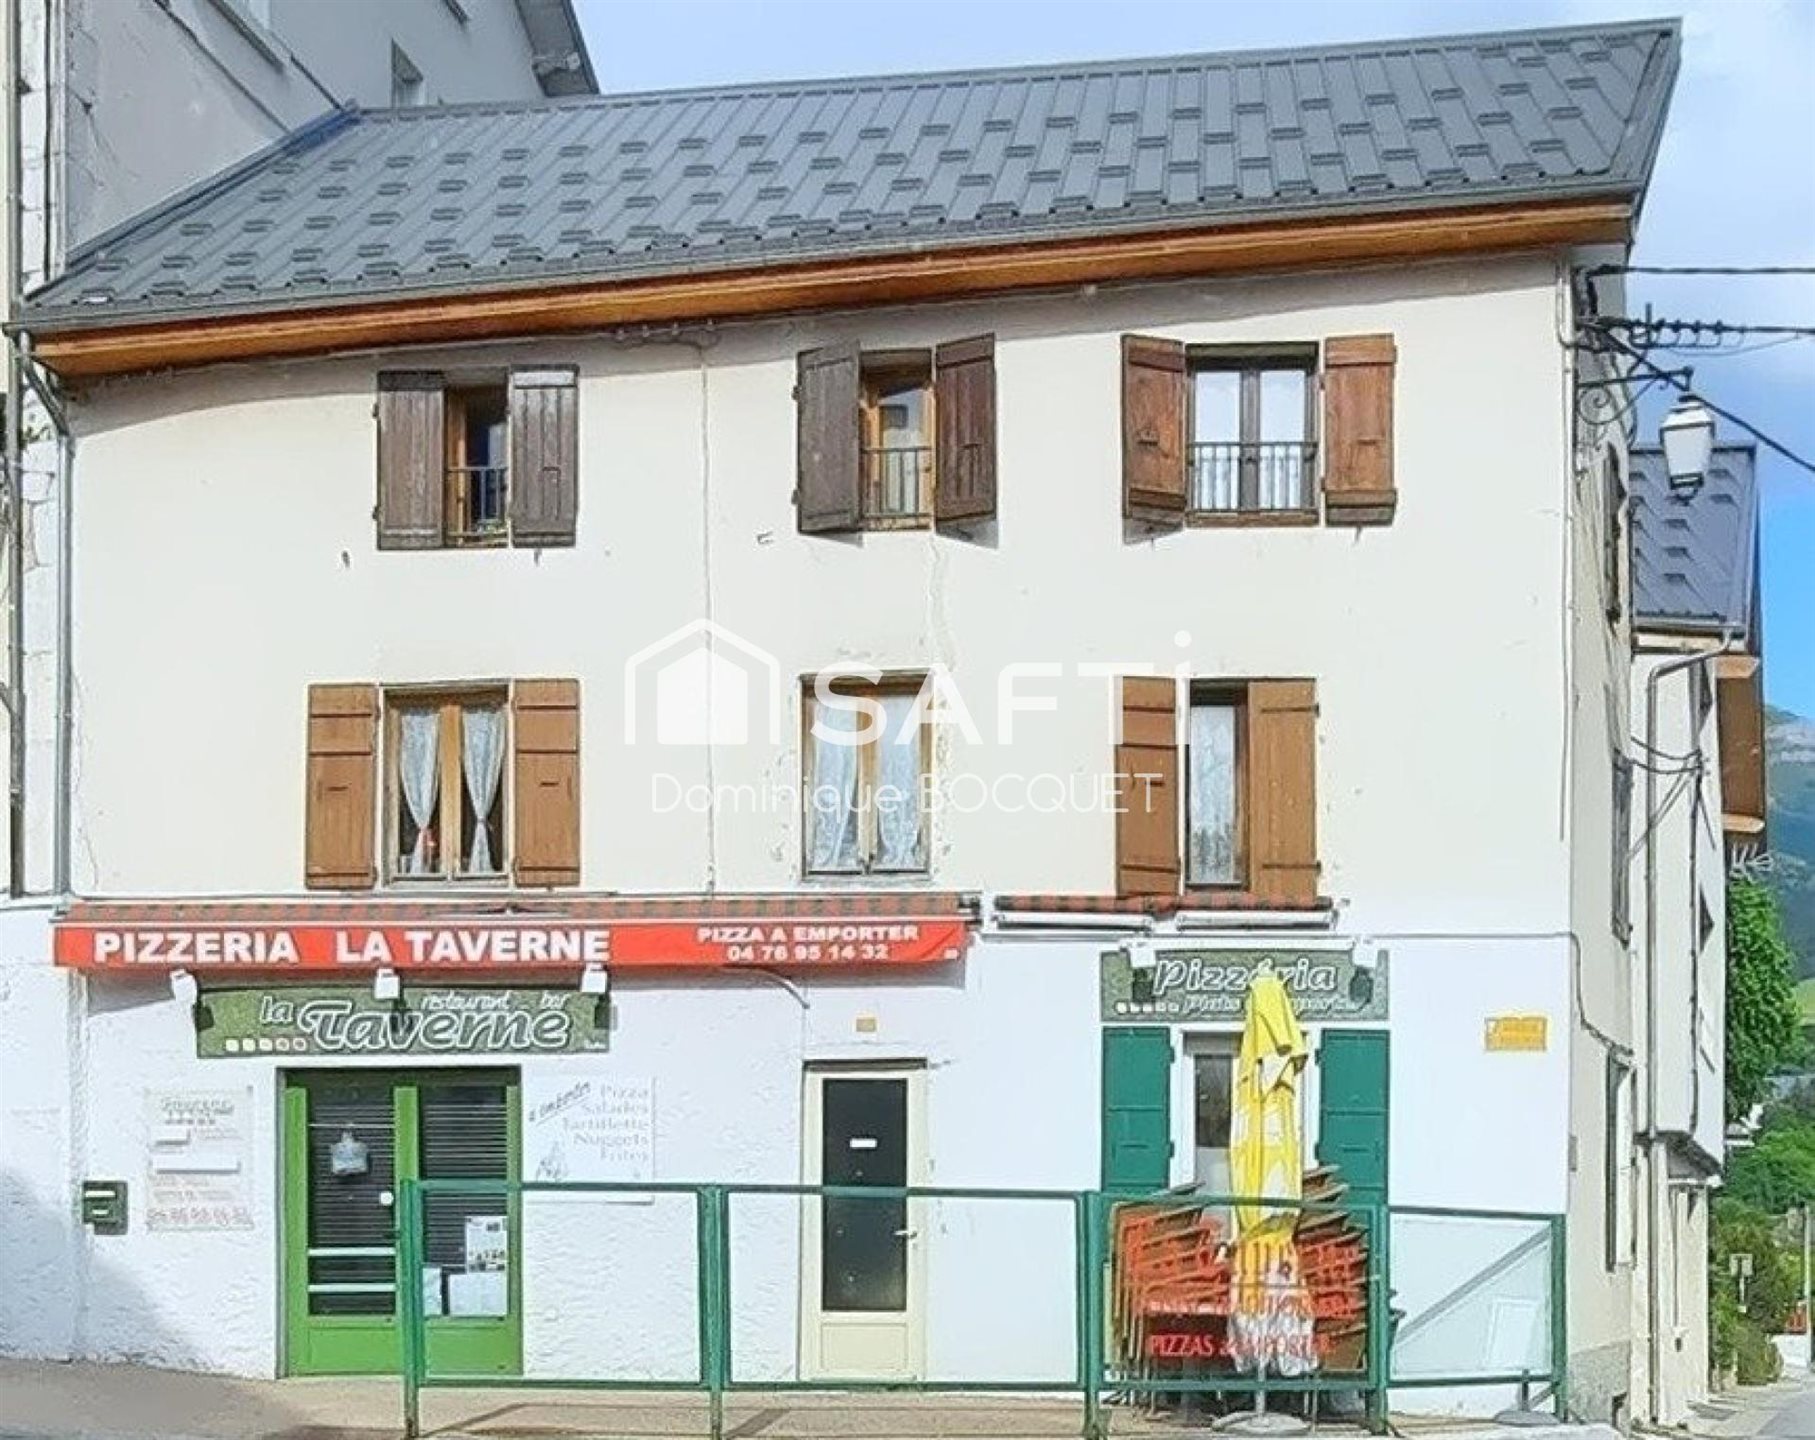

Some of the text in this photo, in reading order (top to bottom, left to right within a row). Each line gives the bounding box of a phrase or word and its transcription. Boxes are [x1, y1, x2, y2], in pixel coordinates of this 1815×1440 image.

[94, 929, 611, 964] PIZZERIA LA TAVERNE
[696, 926, 765, 943] PIZZA
[793, 924, 919, 942] EMPORTER
[727, 945, 755, 961] 04
[828, 944, 857, 960] 14
[861, 943, 889, 960] 32
[1153, 957, 1337, 995] Pizzria
[259, 996, 571, 1050] la Taverne
